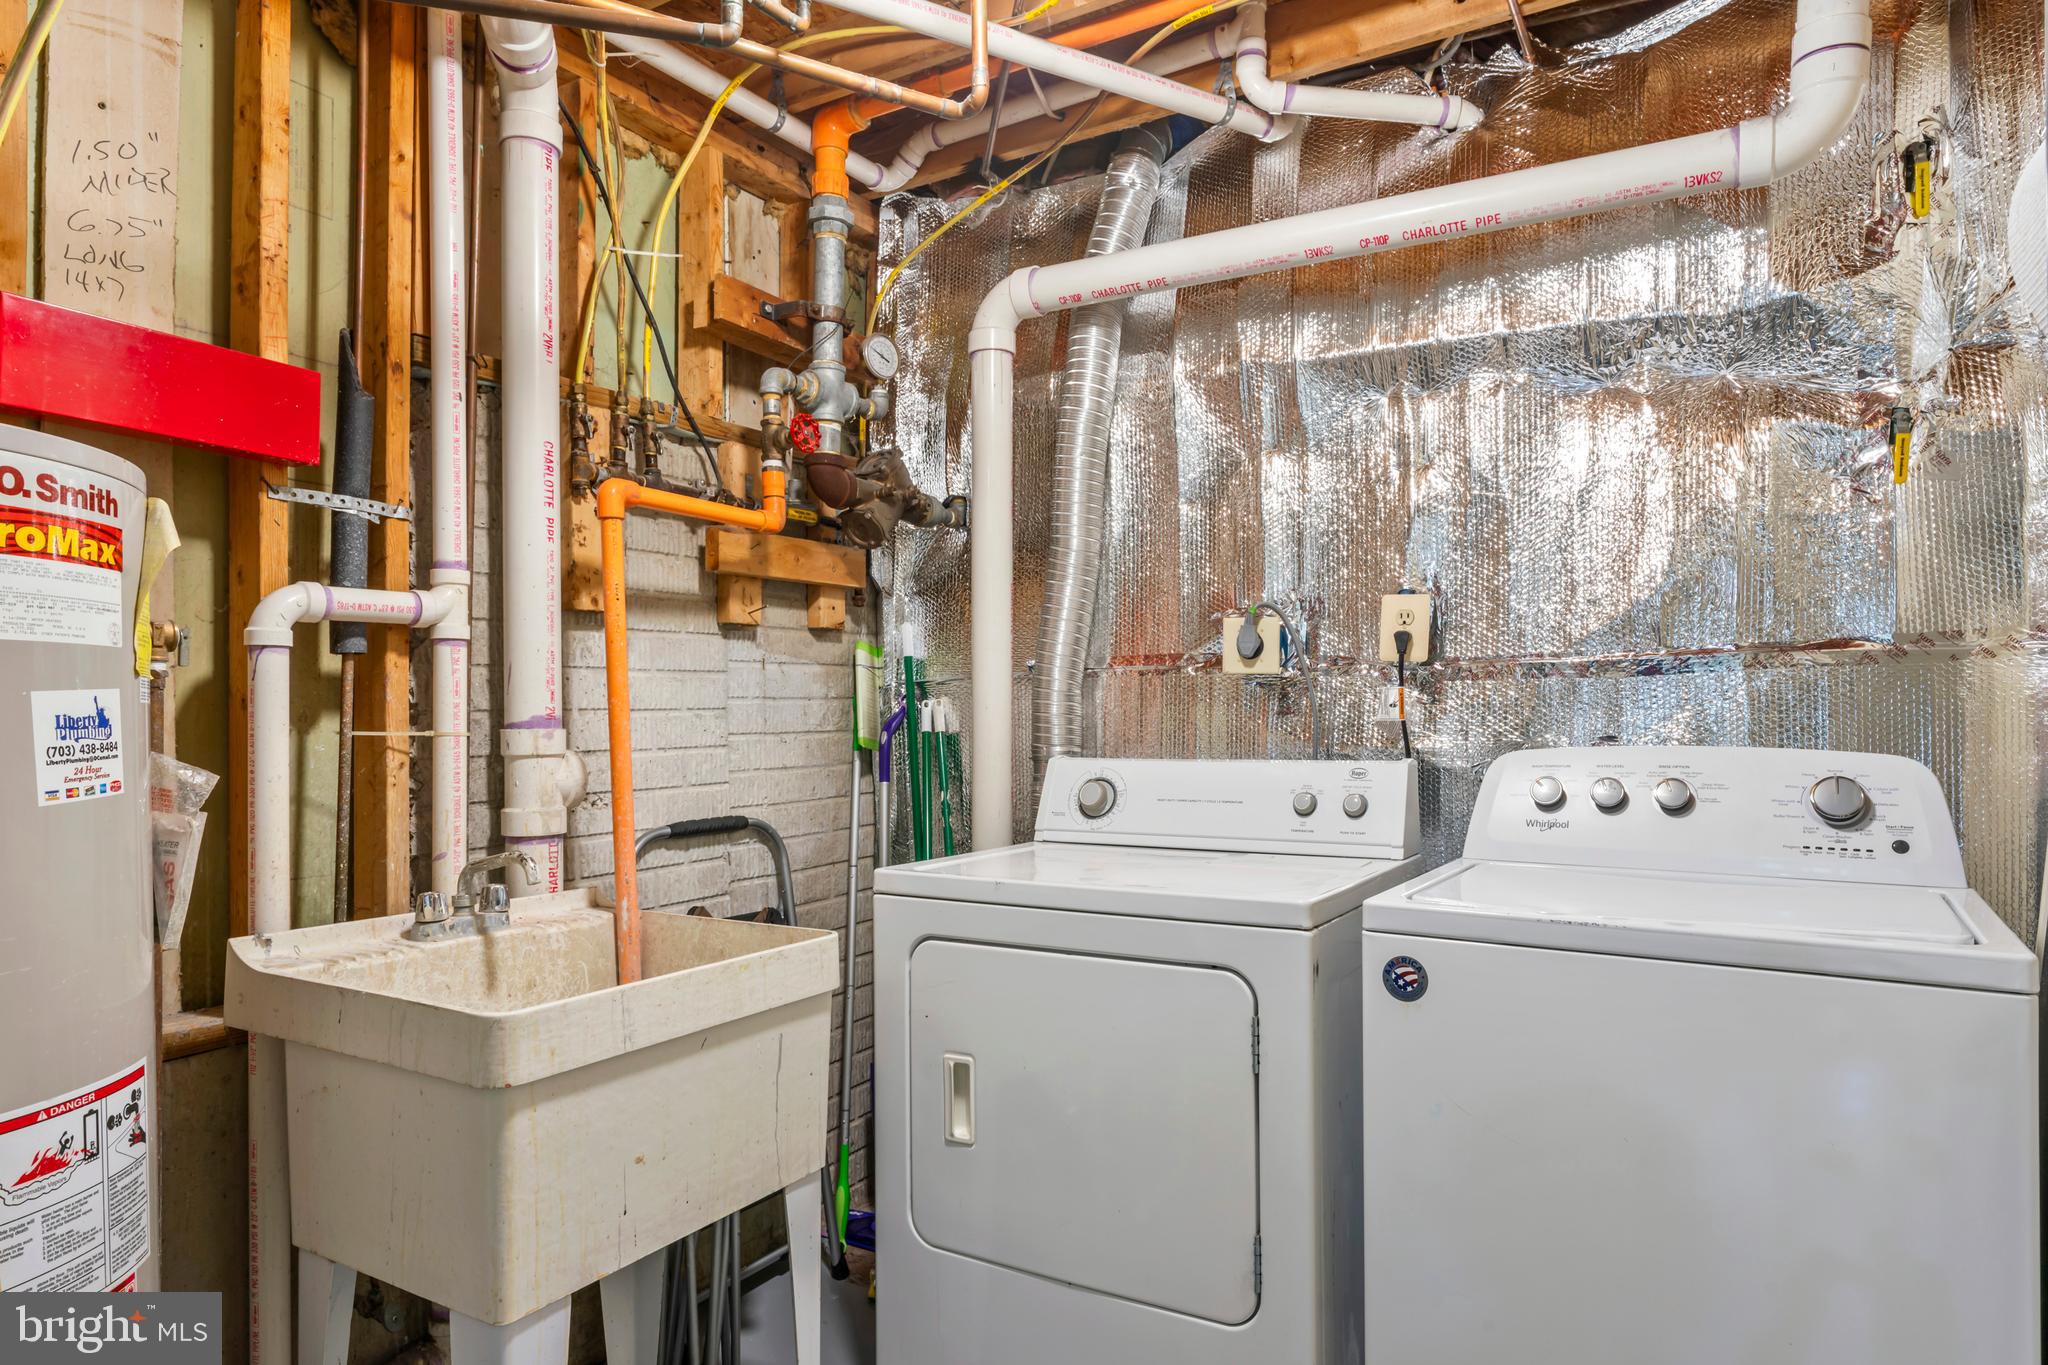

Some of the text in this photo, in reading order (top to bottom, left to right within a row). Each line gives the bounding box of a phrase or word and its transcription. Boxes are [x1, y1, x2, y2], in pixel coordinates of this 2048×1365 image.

[1683, 170, 1724, 190] 13VKS2
[1402, 219, 1468, 242] CHARLOTTE
[1474, 213, 1502, 230] PIPE
[1359, 234, 1390, 249] CP-110P
[64, 244, 144, 272] LONG
[1303, 245, 1335, 259] 13VKS2
[1091, 282, 1143, 299] CHARLOTTE
[1148, 276, 1168, 289] PIPE
[543, 440, 555, 509] CHARLOTTE
[36, 473, 119, 518] Smith
[55, 713, 97, 729] Liberty
[55, 724, 112, 743] Plumbing
[46, 741, 118, 759] (703) 438-8484
[64, 776, 92, 784] Emergency
[74, 765, 102, 776] 24 Hour
[1525, 818, 1569, 832] Whirlpool
[50, 1092, 96, 1117] DANGER
[12, 1176, 67, 1201] Flammable Vapors
